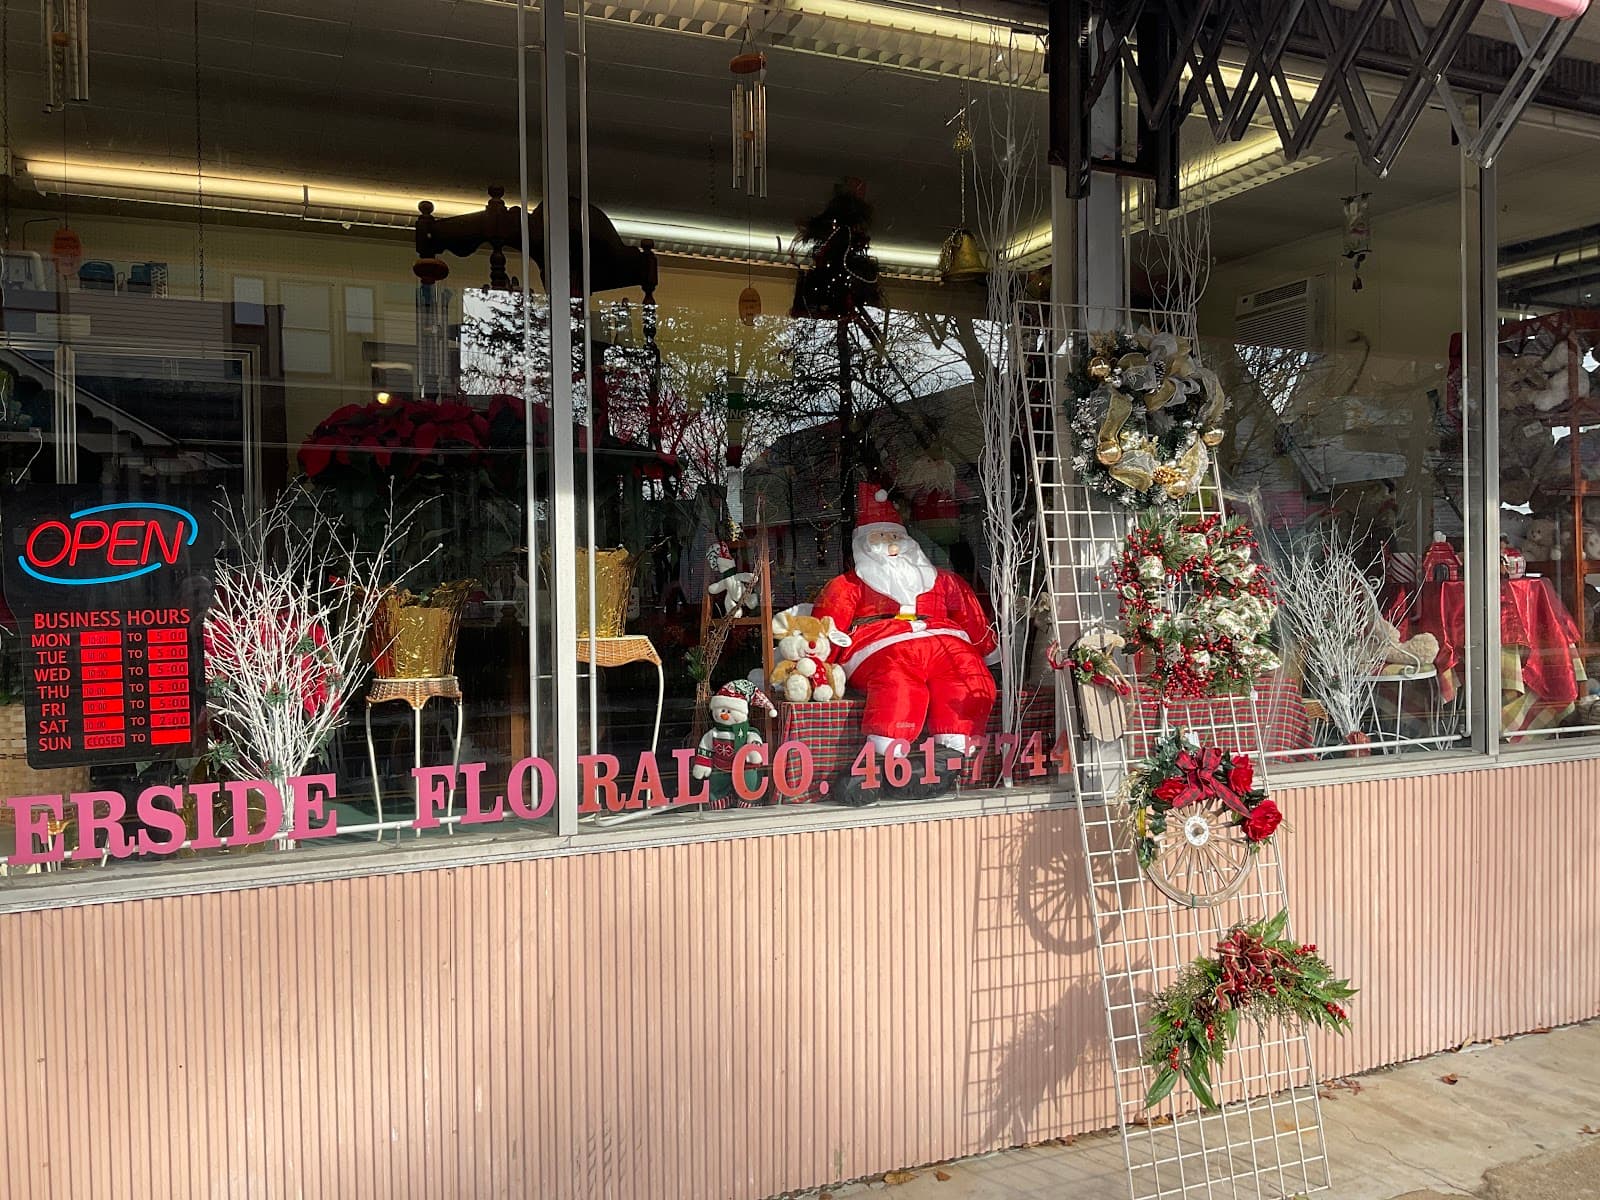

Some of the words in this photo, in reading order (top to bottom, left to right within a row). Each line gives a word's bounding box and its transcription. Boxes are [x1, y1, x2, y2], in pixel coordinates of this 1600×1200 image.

[26, 520, 185, 568] OPEN
[34, 610, 121, 629] BUSINESS
[127, 608, 190, 626] HOURS
[31, 633, 71, 648] MON
[127, 632, 142, 642] TO
[156, 631, 186, 641] 5:00
[36, 650, 67, 665] TUE
[127, 649, 143, 659] TO
[157, 647, 186, 658] 5:00
[34, 667, 71, 682] WED
[128, 666, 144, 676] TO
[157, 664, 186, 674] 5:00
[37, 685, 70, 699] THU
[129, 683, 144, 693] TO
[157, 681, 186, 692] 5:00
[41, 702, 66, 717] FRI
[129, 700, 145, 710] TO
[159, 698, 187, 708] 5:00
[39, 719, 69, 735] SAT
[130, 716, 146, 726] TO
[159, 715, 187, 726] 2:00
[38, 736, 72, 752] SUN
[86, 735, 124, 747] CLOSED
[130, 733, 146, 743] TO
[7, 773, 337, 866] ERSIDE
[731, 740, 830, 801] CO.
[851, 731, 1073, 790] 461-7744
